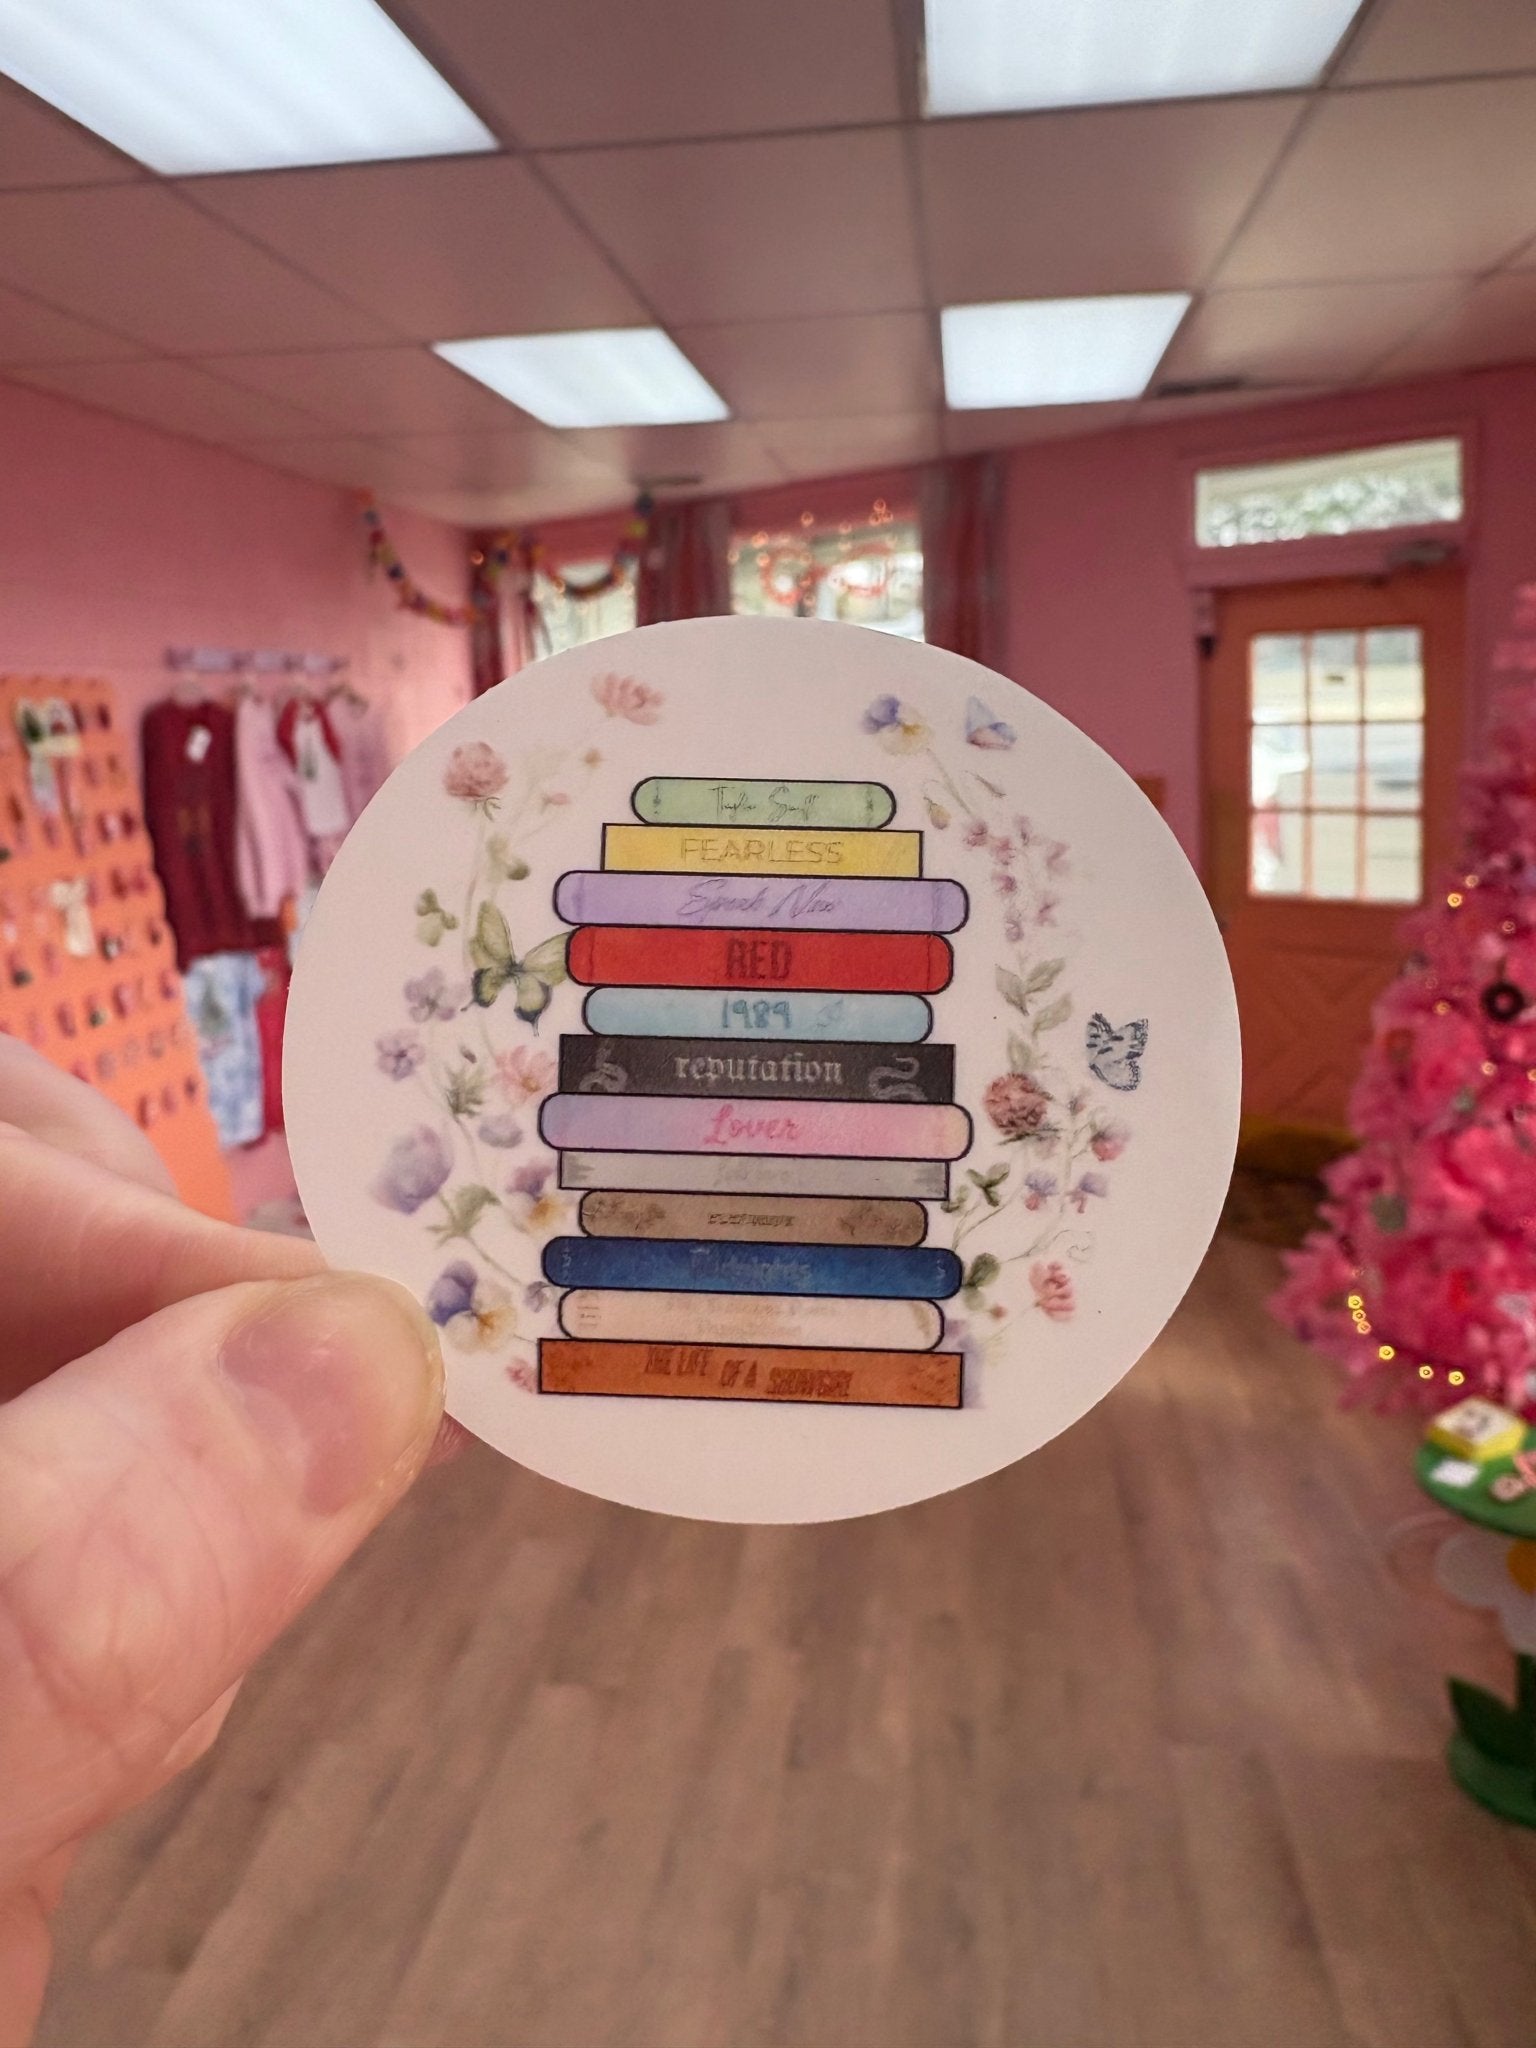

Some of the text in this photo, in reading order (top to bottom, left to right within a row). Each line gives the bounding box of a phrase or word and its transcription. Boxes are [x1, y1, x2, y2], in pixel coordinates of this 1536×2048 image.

[680, 838, 844, 864] FEARLESS
[725, 938, 793, 981] RED
[721, 998, 793, 1030] 1989
[674, 1053, 844, 1088] reputation
[703, 1103, 799, 1145] Lover
